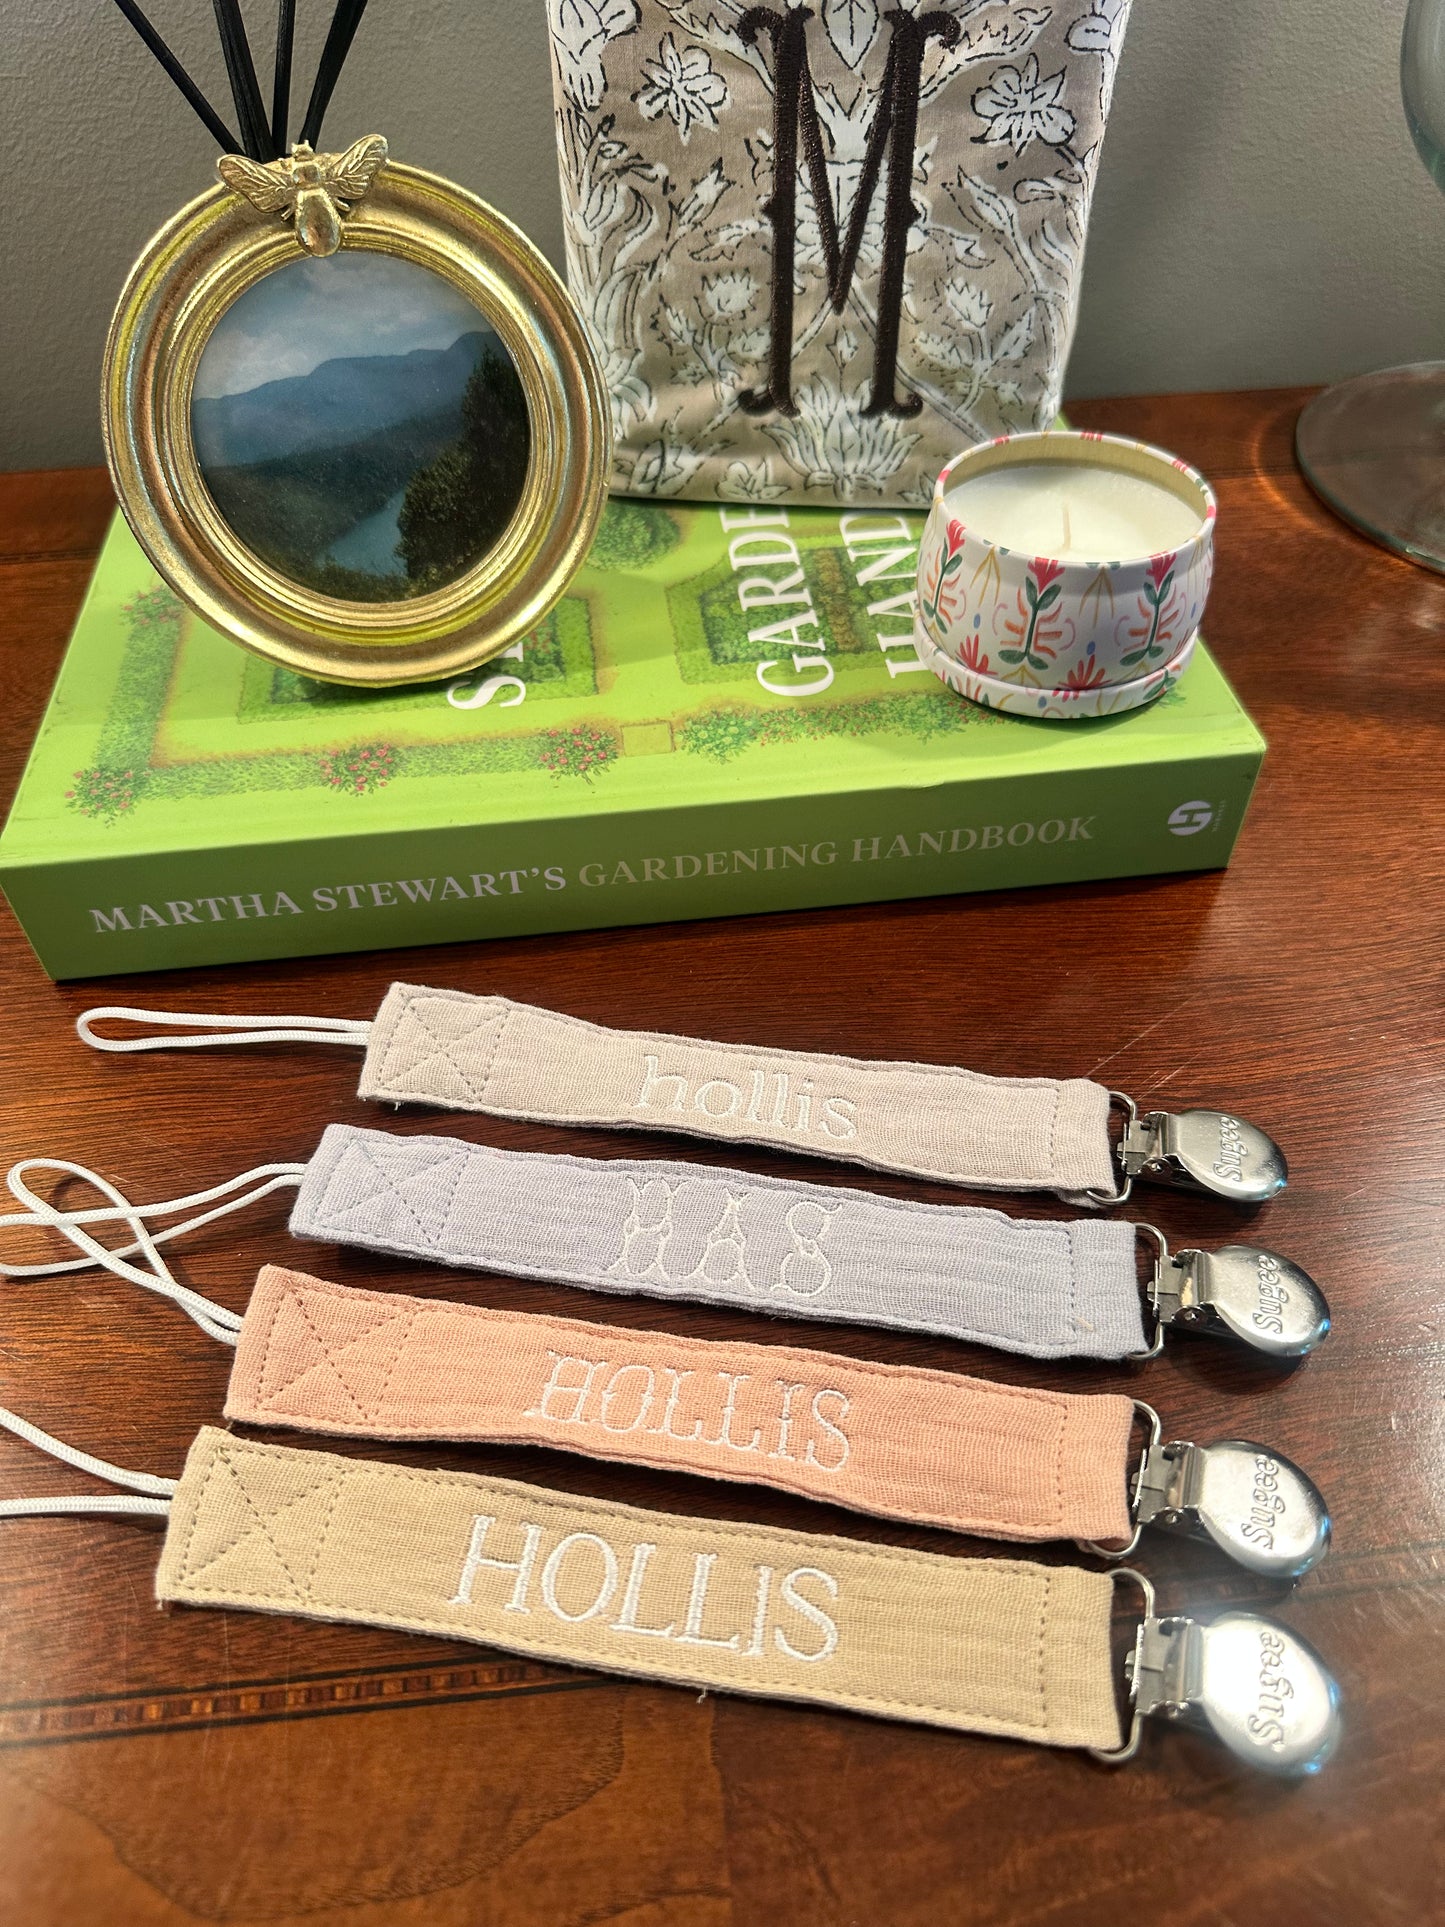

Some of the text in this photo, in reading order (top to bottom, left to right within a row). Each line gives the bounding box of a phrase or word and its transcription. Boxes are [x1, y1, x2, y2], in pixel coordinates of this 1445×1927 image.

[737, 5, 962, 418] M
[88, 815, 1097, 933] MARTHA STEWART'S GARDENING HANDBOOK
[632, 1055, 857, 1140] hollis
[1212, 1116, 1250, 1183] Sugee
[1252, 1254, 1290, 1335] Sugee
[523, 1350, 850, 1472] HOLLIS
[1240, 1454, 1286, 1550] Sugee
[448, 1514, 838, 1662] HOLLIS
[1247, 1630, 1295, 1752] Sugee
